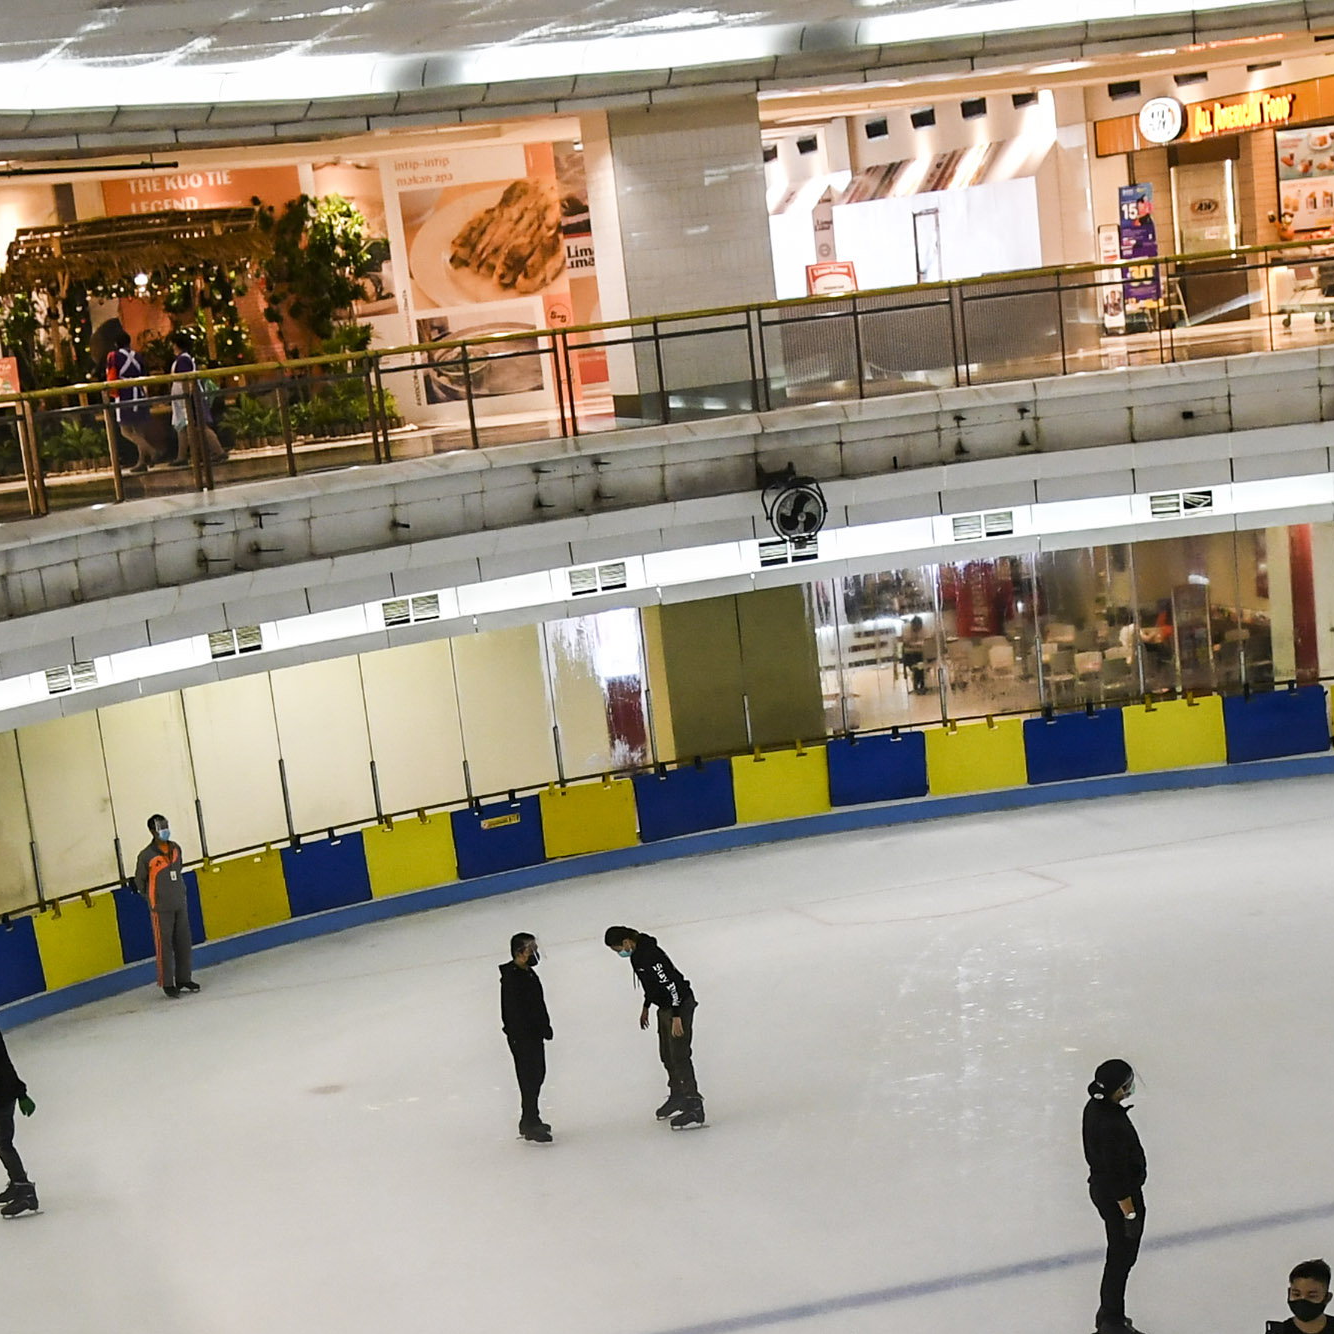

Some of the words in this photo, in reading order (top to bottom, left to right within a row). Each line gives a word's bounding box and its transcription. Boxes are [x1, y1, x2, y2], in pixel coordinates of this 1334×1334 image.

[394, 156, 450, 172] intip-intip
[129, 178, 161, 194] THE
[165, 173, 203, 191] KUO
[205, 170, 232, 187] TIE
[396, 173, 433, 187] makan
[435, 172, 453, 185] apa
[566, 245, 595, 258] Lim
[567, 257, 595, 269] ima
